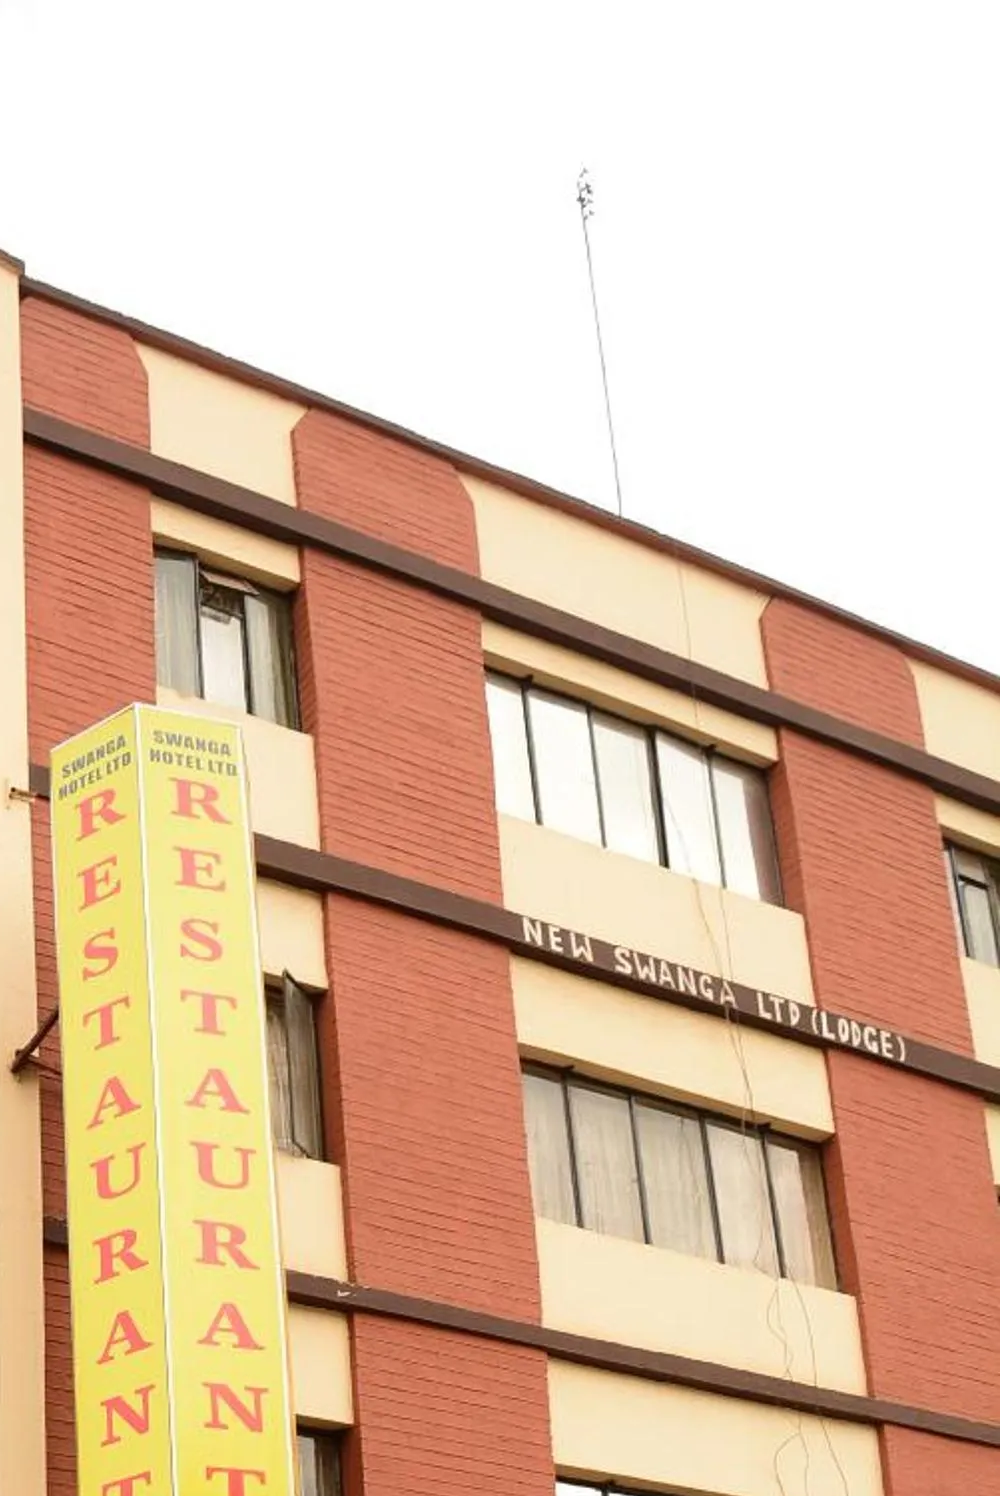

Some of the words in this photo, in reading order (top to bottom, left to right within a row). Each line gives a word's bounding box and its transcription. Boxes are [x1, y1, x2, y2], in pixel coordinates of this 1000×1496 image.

[62, 735, 126, 778] SWANGA
[150, 751, 203, 772] HOTEL
[207, 756, 238, 776] LTD
[153, 730, 231, 757] SWANGA
[59, 767, 102, 801] HOTEL
[106, 751, 132, 776] LTD
[522, 915, 593, 963] NEW
[614, 946, 739, 1008] SWANGA
[757, 992, 801, 1028] LTD
[811, 1007, 906, 1063] (LODGE)
